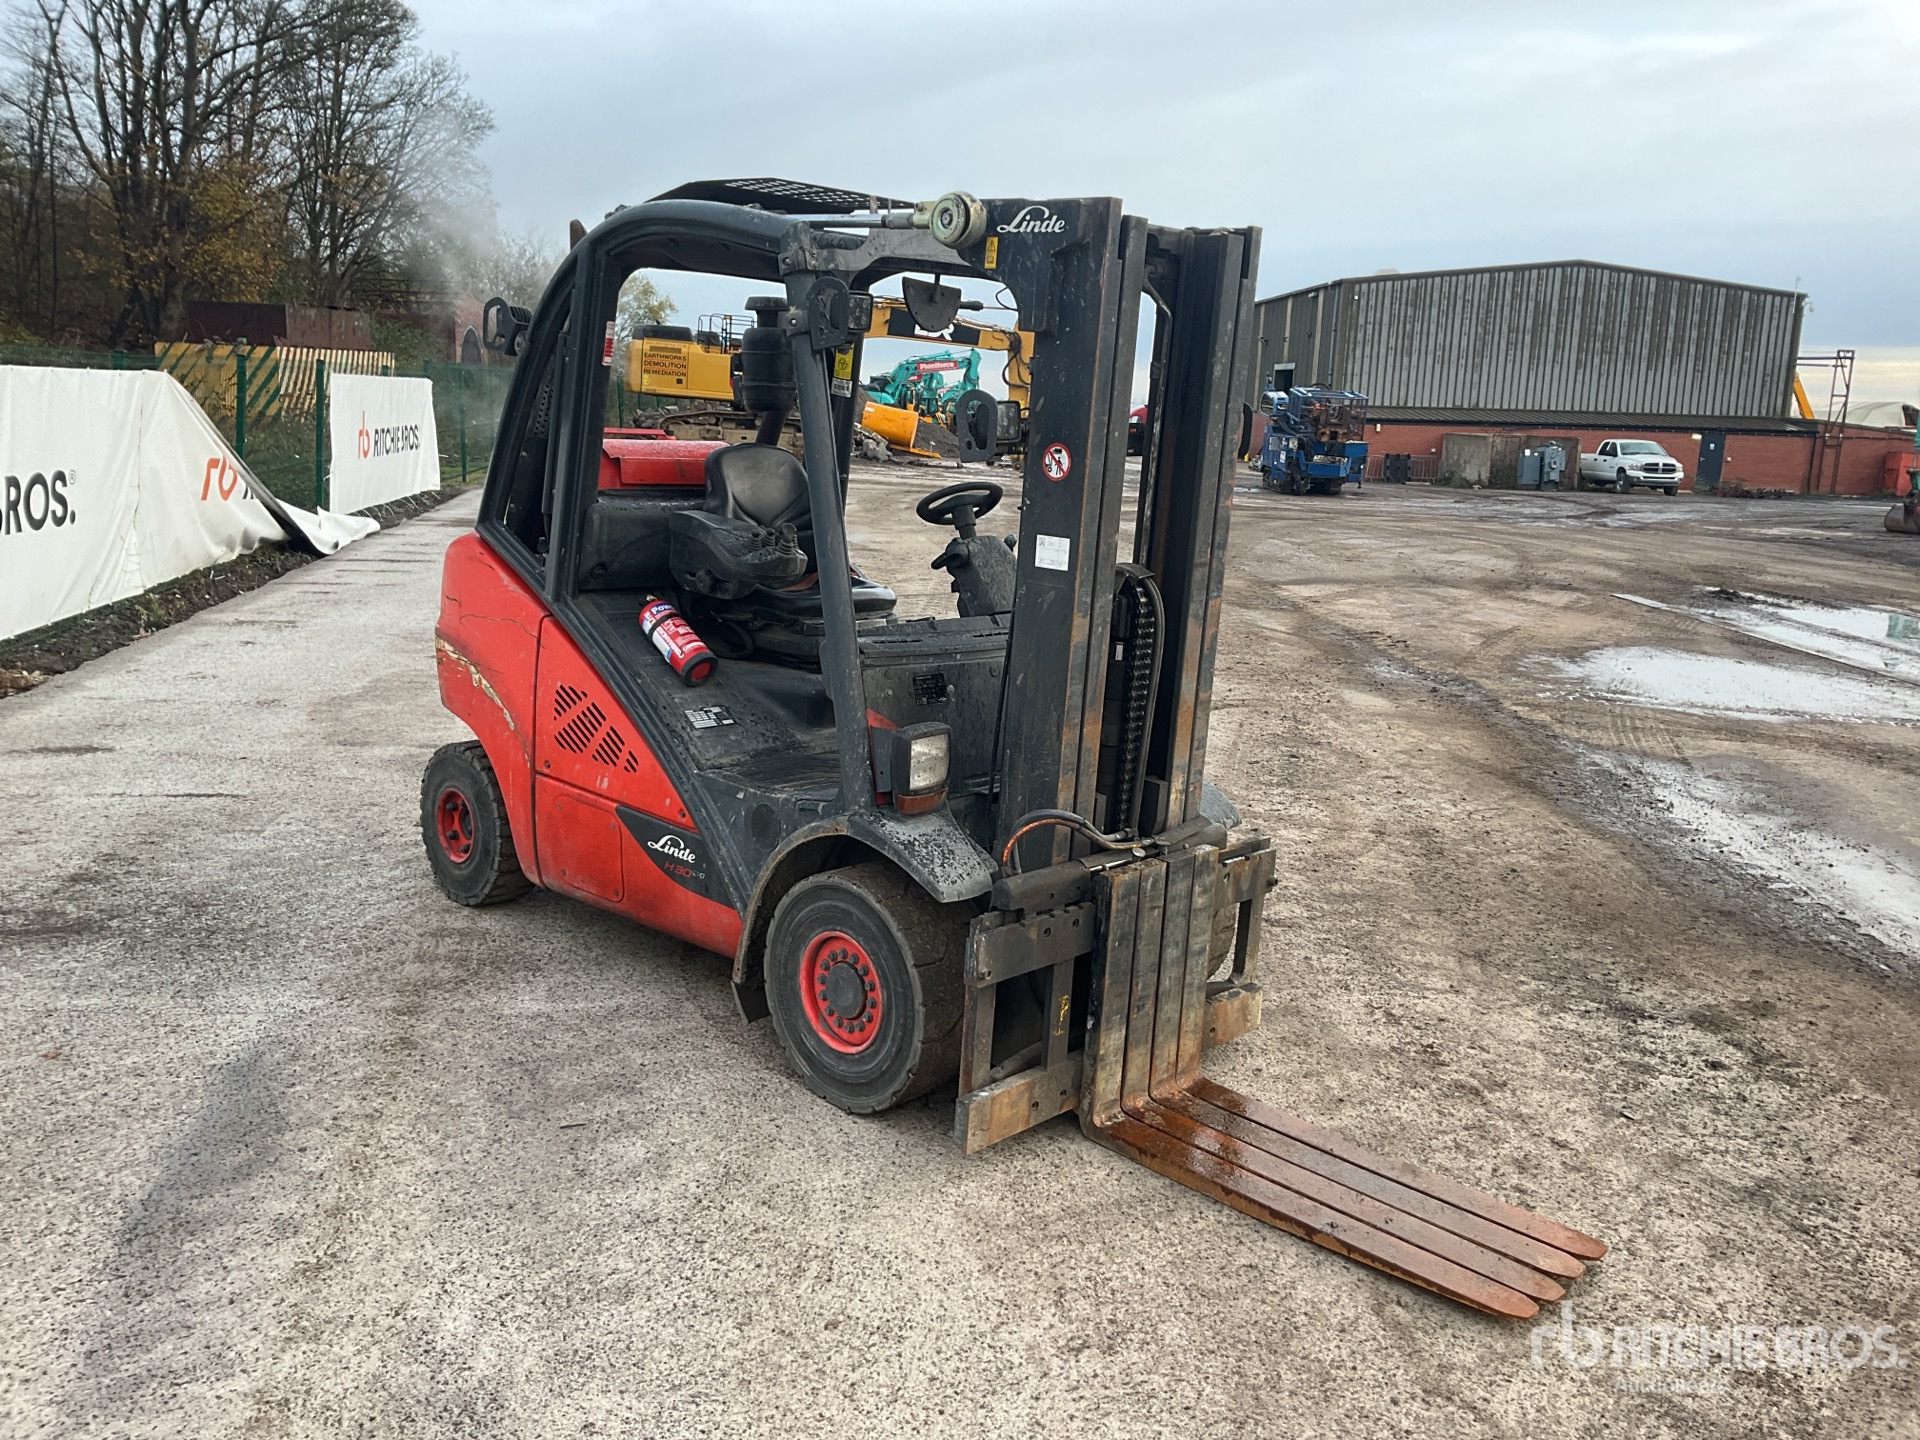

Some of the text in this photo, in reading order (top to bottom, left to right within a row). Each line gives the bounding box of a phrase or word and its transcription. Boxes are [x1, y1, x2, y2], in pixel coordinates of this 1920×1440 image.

[996, 205, 1065, 233] Linde
[644, 353, 687, 361] EARTHWORKS
[644, 361, 687, 369] DEMOLITION
[920, 361, 955, 369] Plantforce
[644, 369, 687, 377] REMEDIATION
[373, 426, 400, 457] RITCHIE
[0, 470, 76, 535] ROS.
[647, 834, 696, 864] Linde
